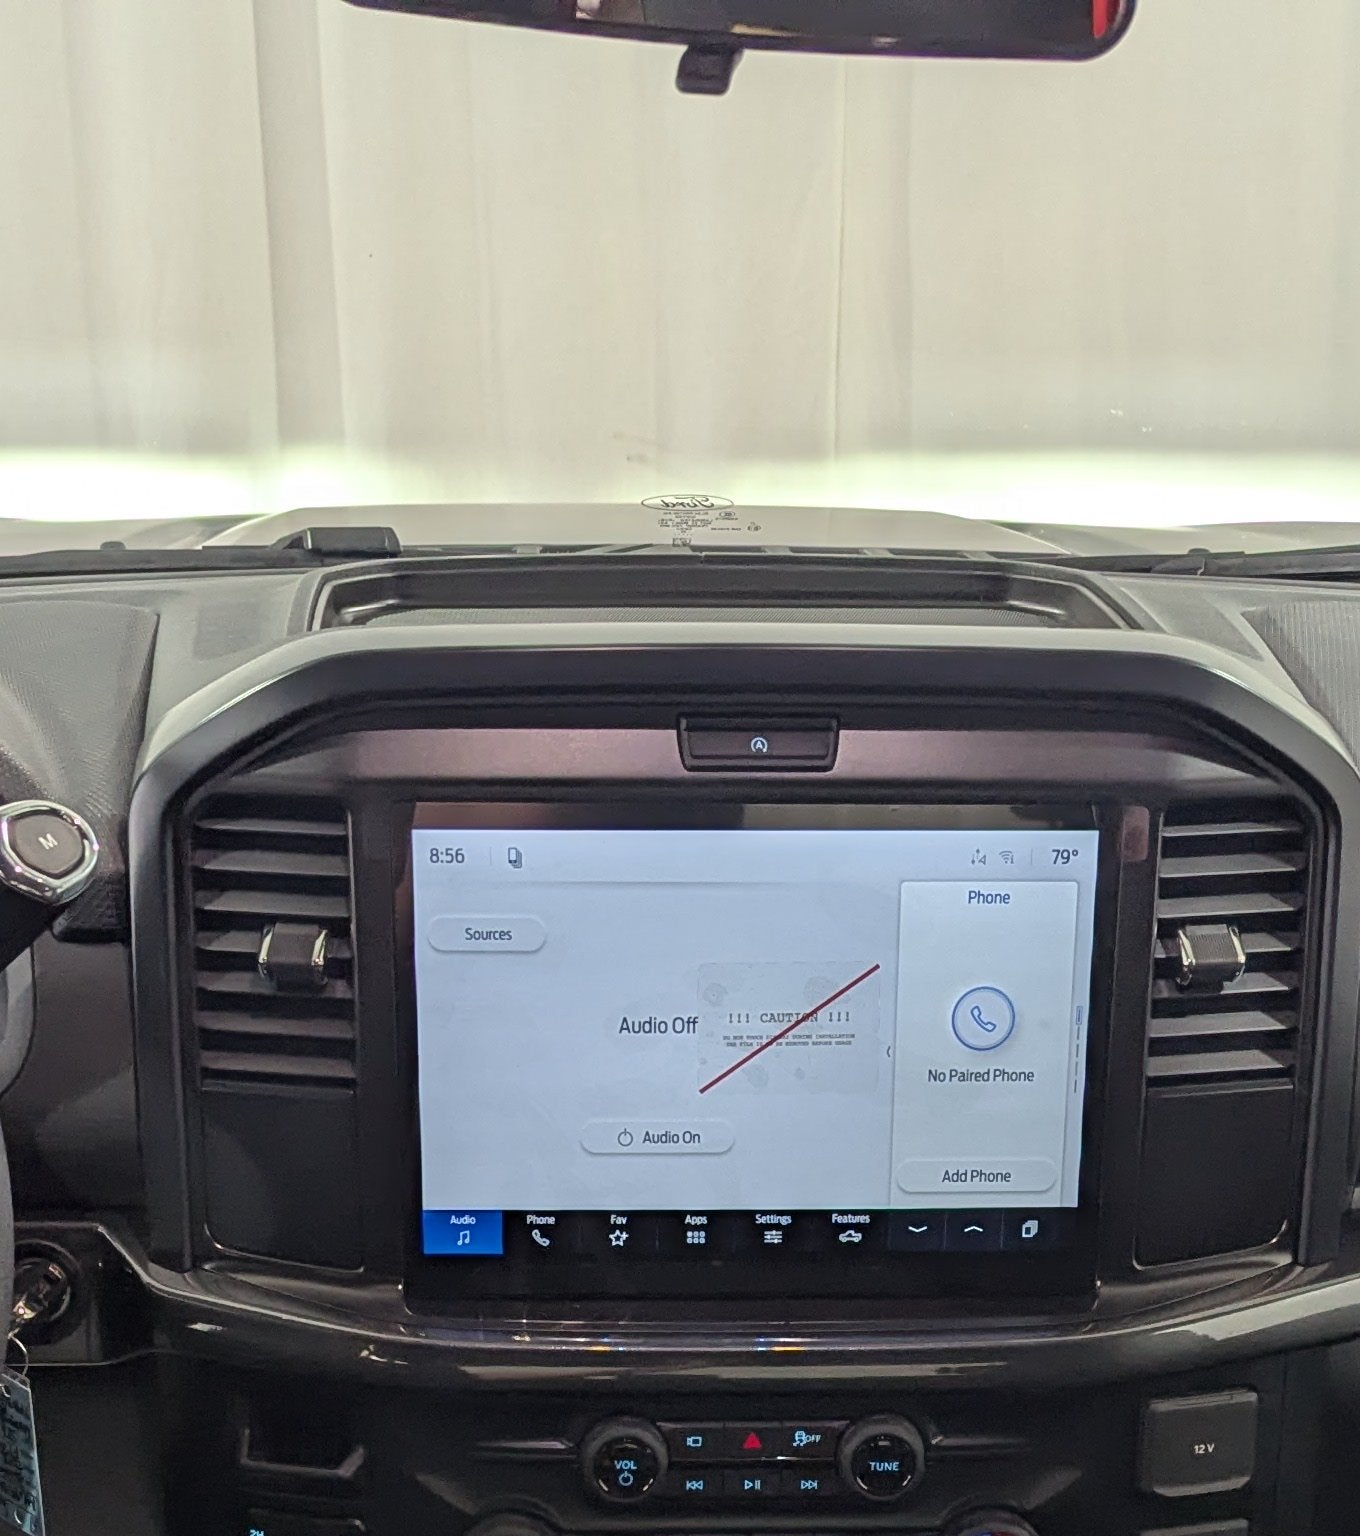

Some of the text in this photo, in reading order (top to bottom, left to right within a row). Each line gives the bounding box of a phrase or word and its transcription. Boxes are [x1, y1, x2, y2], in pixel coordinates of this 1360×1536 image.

[38, 833, 58, 850] M
[429, 847, 465, 864] 8:56
[967, 889, 1011, 905] Phone
[464, 927, 513, 941] Sources
[760, 1012, 818, 1023] CAUTIN
[619, 1016, 699, 1034] Audio Off
[927, 1068, 1035, 1083] No Paired Phone
[642, 1130, 701, 1144] Audio On
[942, 1169, 1012, 1183] Add Phone
[449, 1214, 477, 1225] Audio
[526, 1214, 556, 1225] Phone
[610, 1214, 628, 1225] Fav
[684, 1214, 708, 1226] Apps
[755, 1213, 792, 1226] Settings
[831, 1213, 871, 1224] Features
[1194, 1443, 1215, 1455] 12 V
[614, 1459, 638, 1471] VOL
[869, 1461, 899, 1472] TUNE
